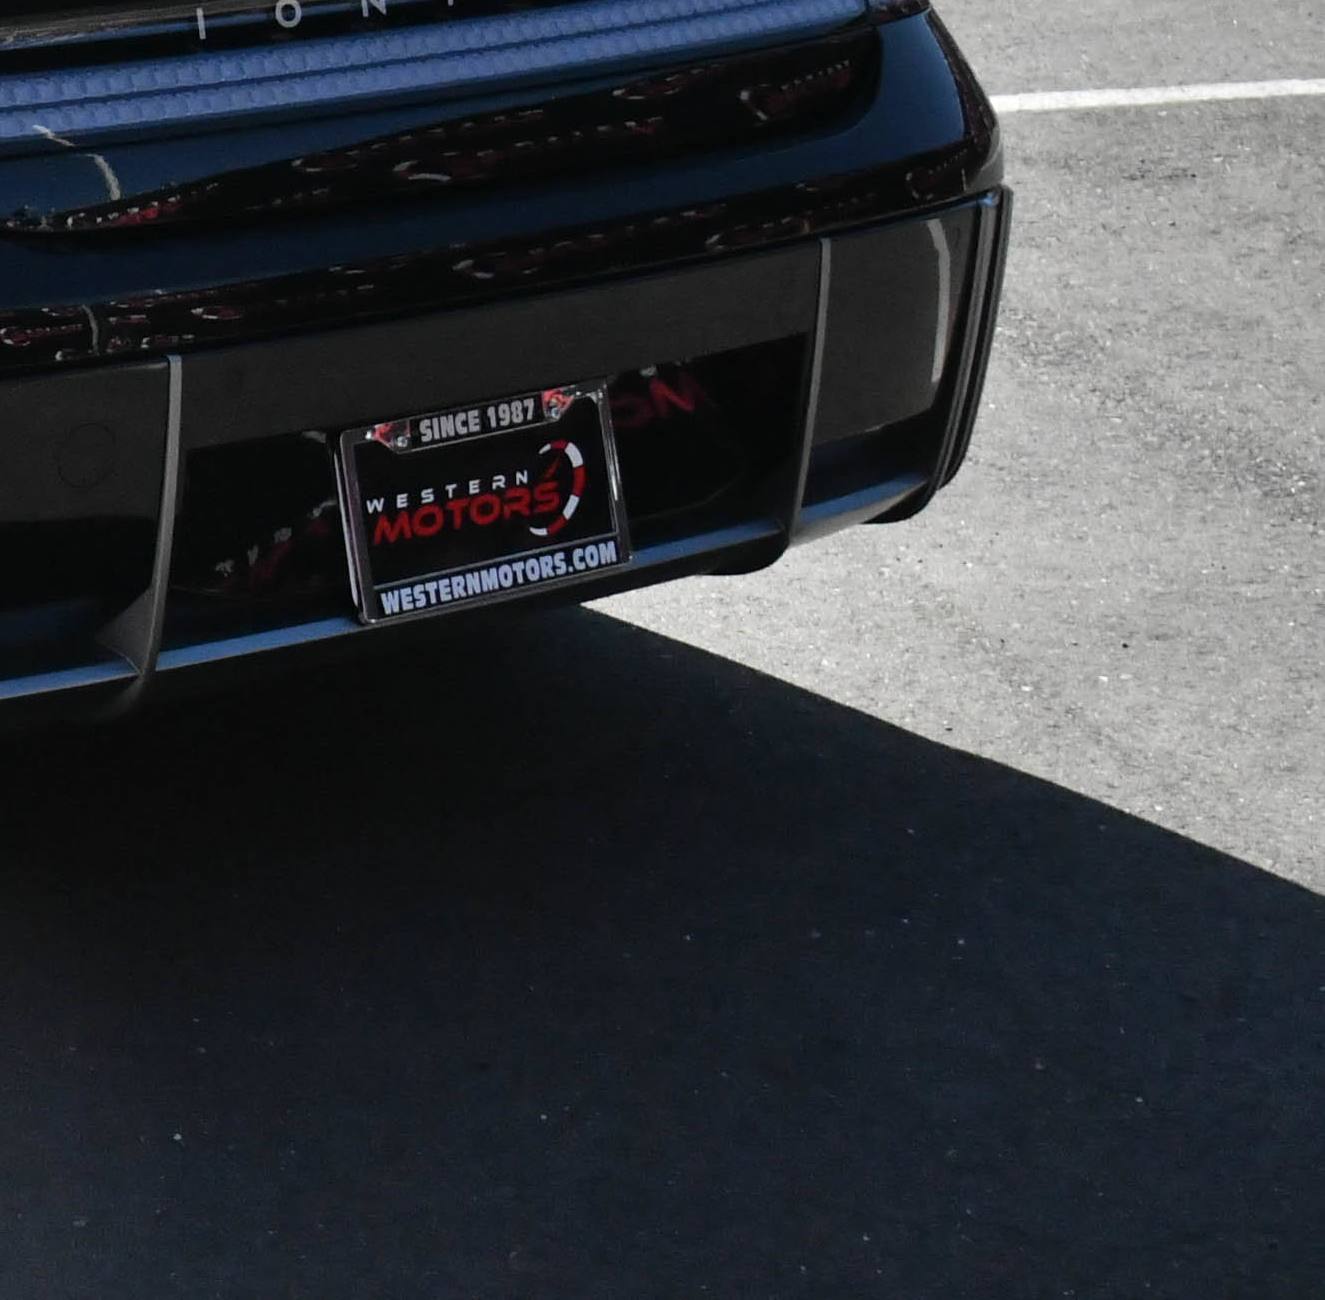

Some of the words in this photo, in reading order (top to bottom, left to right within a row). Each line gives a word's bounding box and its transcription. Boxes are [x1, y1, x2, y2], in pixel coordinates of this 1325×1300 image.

[419, 409, 480, 442] SINCE
[487, 398, 535, 428] 1987
[367, 470, 528, 514] WESTERN
[374, 481, 560, 545] MOTORS
[380, 541, 618, 615] WESTERNMOTORS.COM
